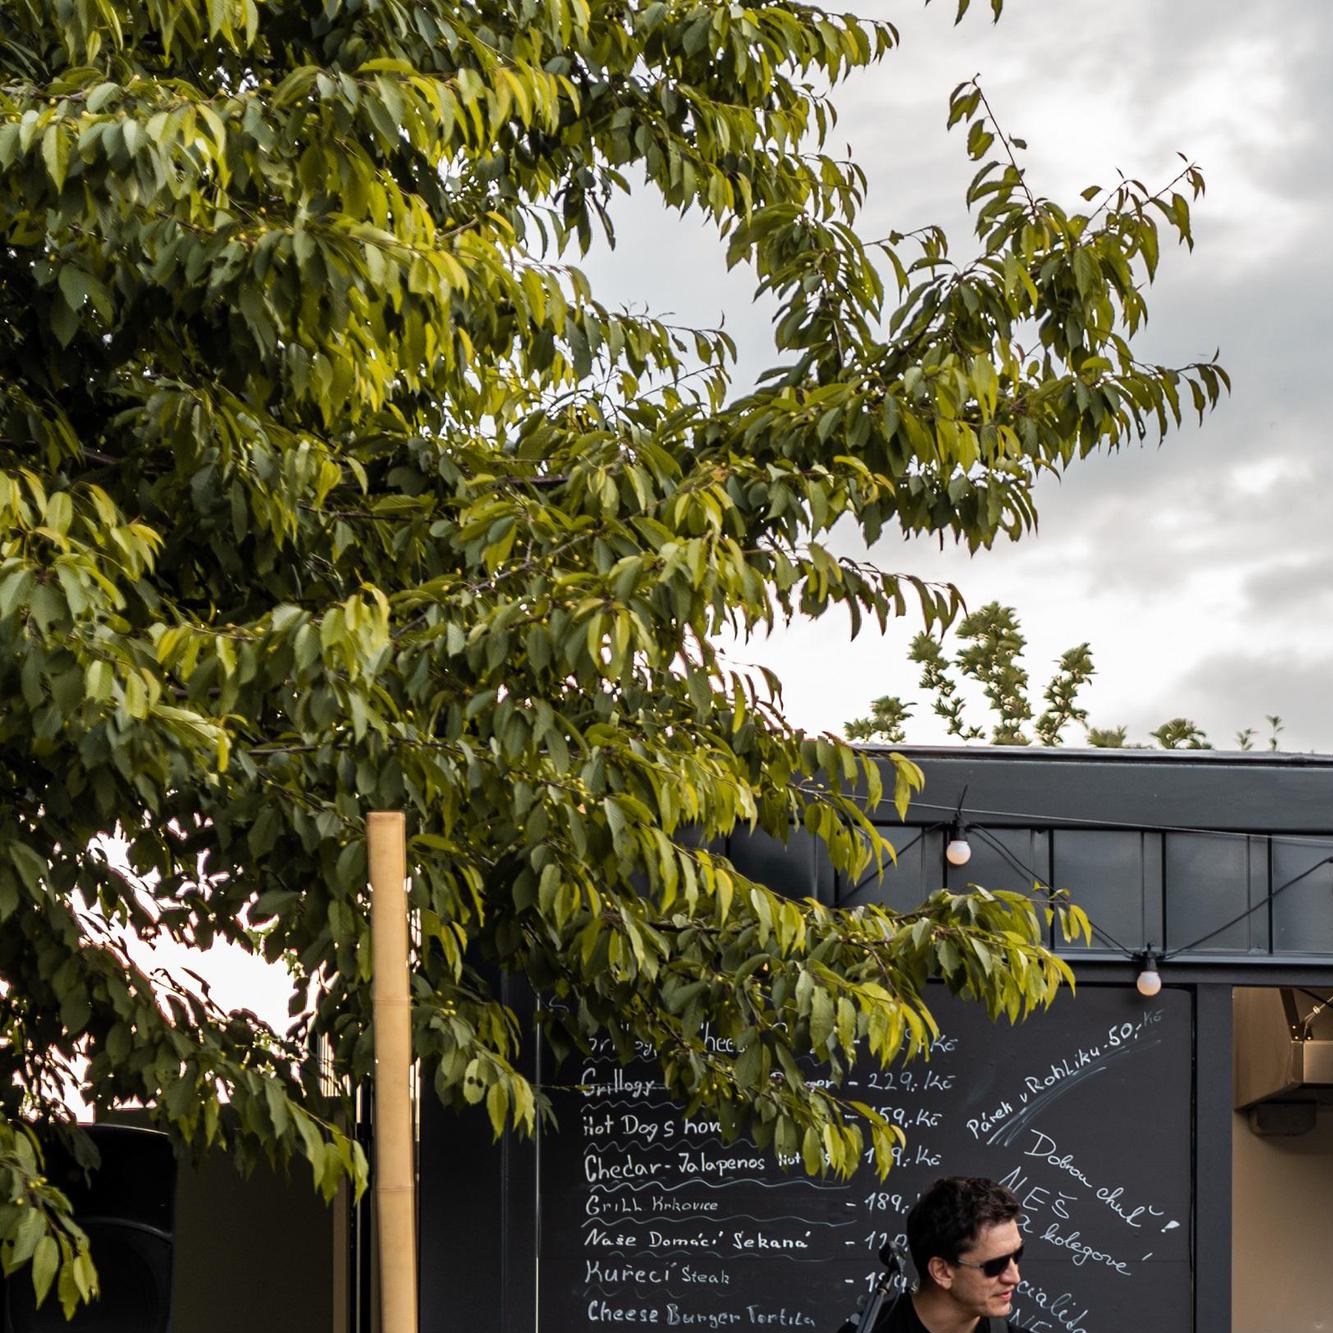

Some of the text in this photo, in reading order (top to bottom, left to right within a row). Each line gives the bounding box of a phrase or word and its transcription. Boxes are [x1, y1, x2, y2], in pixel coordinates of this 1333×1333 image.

[923, 1070, 956, 1091] Kč
[917, 1109, 943, 1128] Kč
[864, 1146, 911, 1168] 19,-
[915, 1145, 942, 1167] Kč
[1023, 1128, 1093, 1188] Dobrou
[587, 1300, 659, 1323] Cheese
